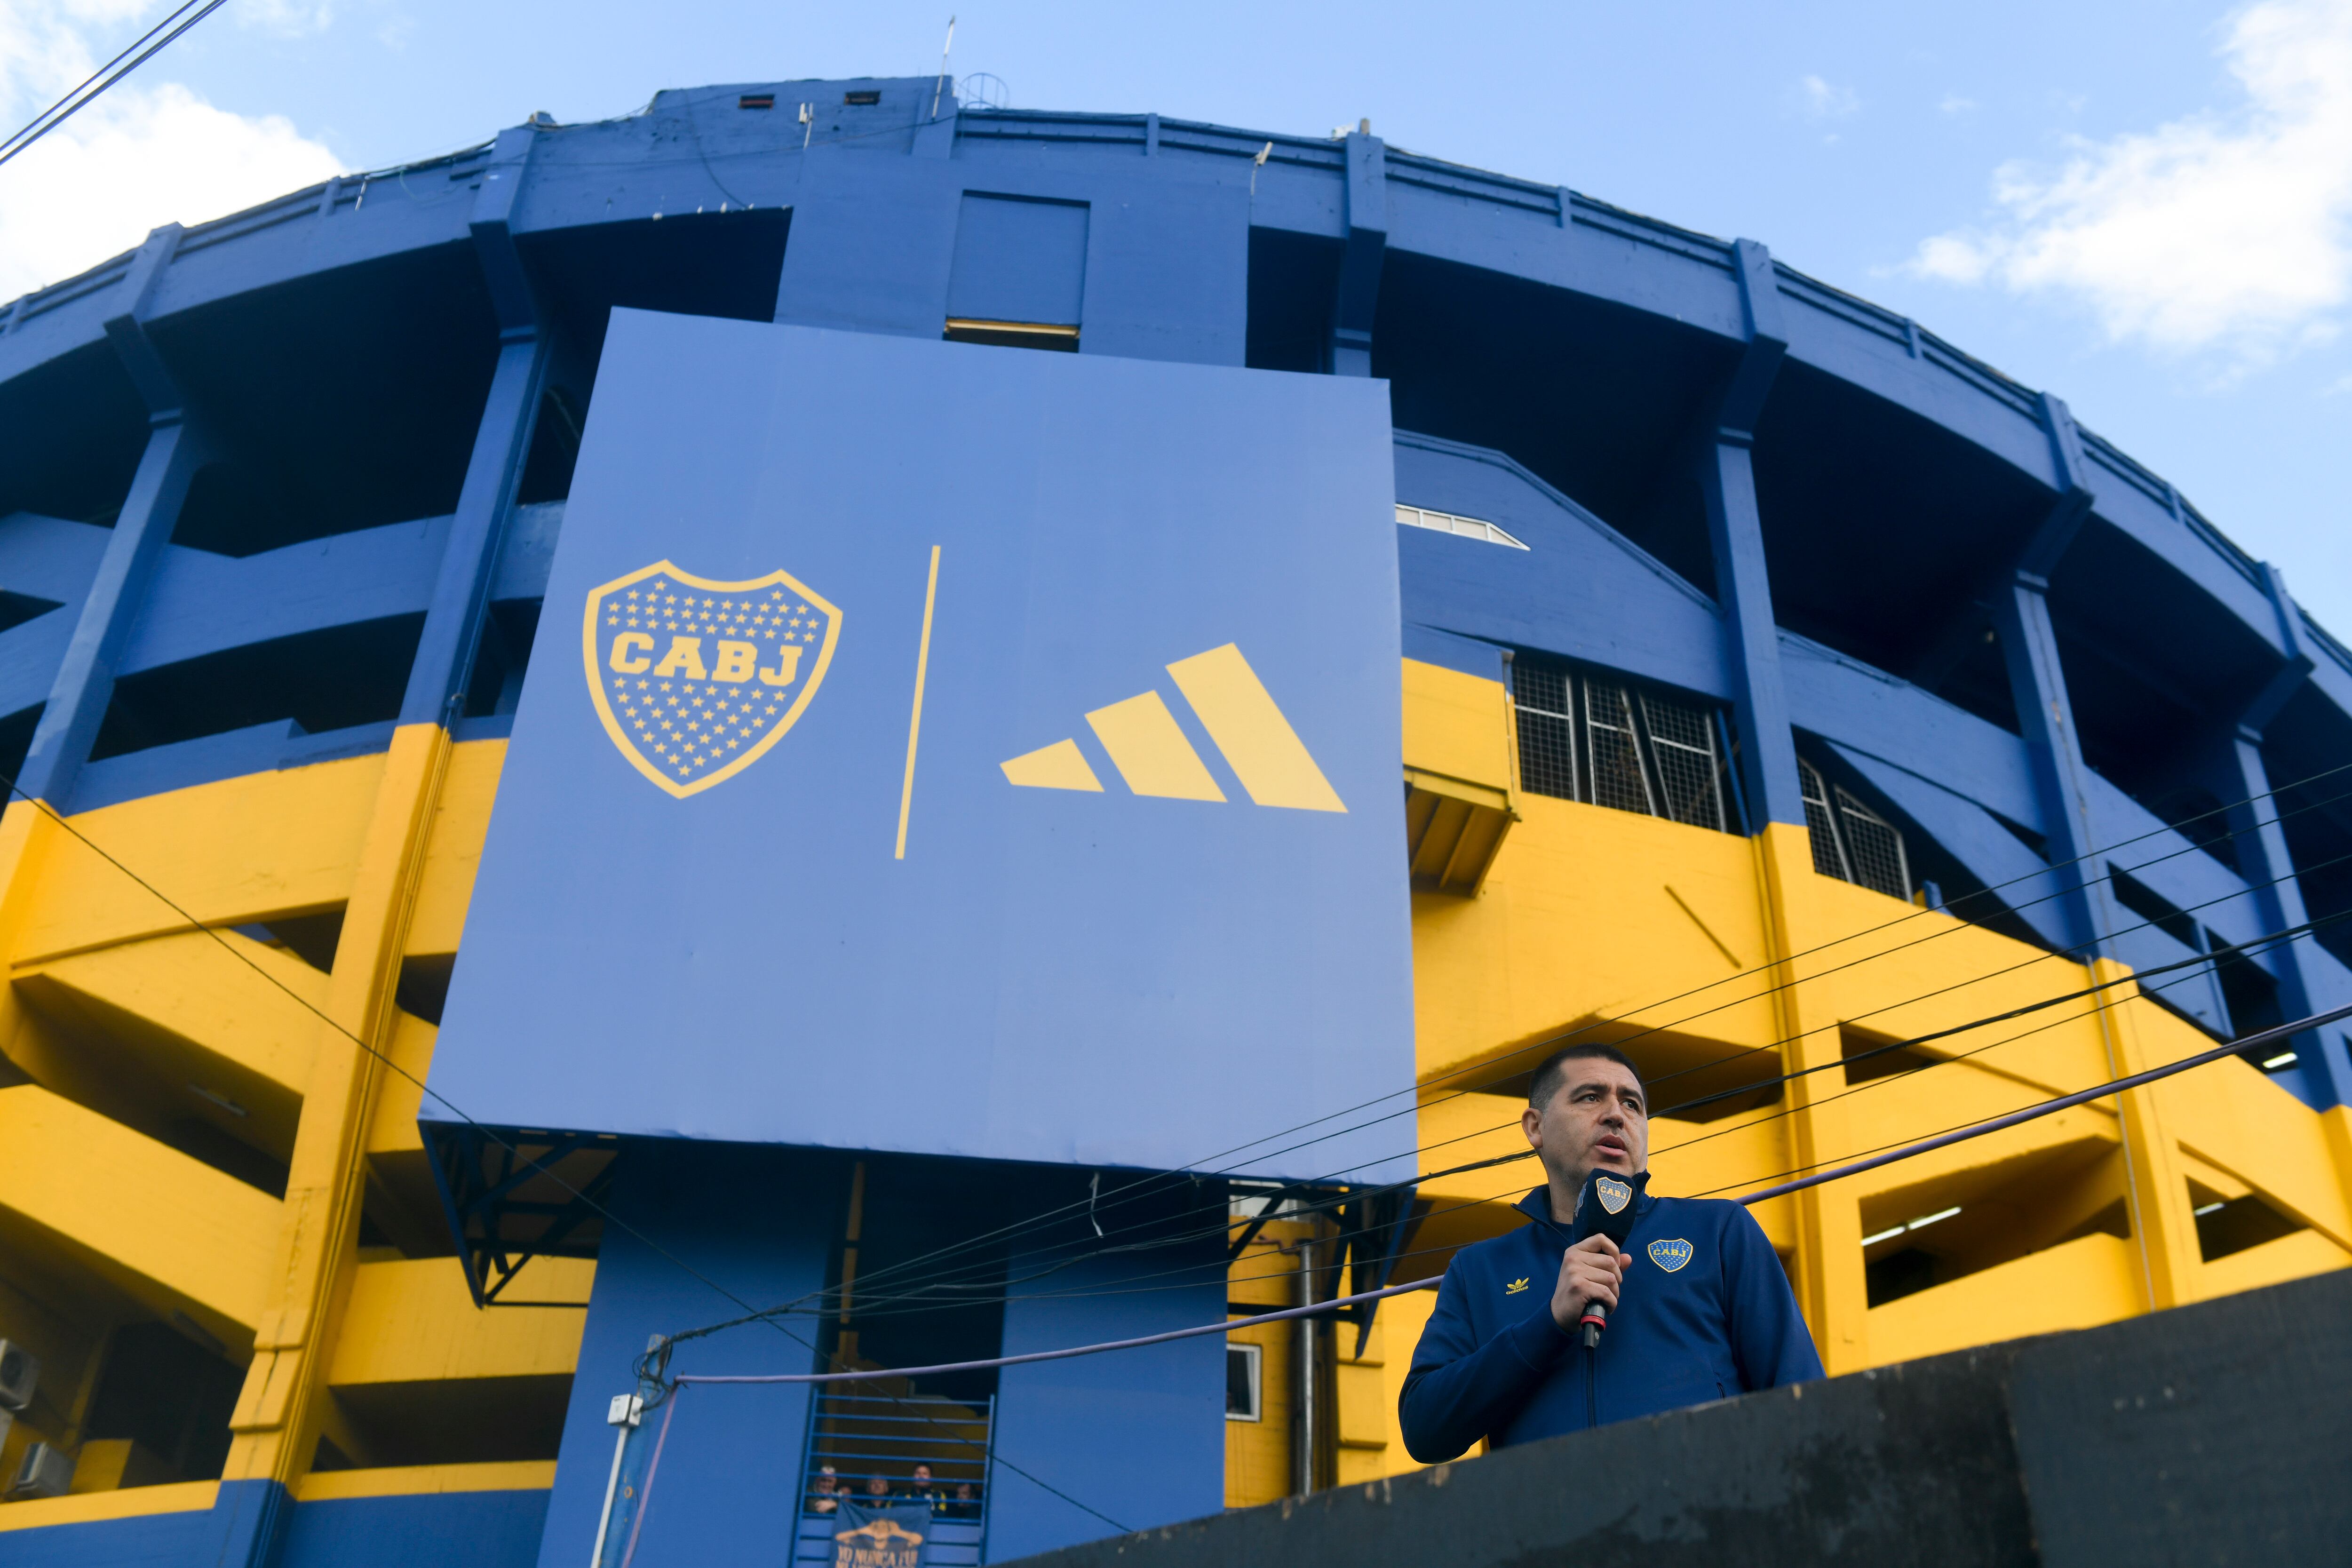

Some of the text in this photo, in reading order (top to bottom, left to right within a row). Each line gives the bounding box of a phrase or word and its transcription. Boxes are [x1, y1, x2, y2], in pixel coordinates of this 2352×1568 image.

[609, 631, 803, 687] CABJ
[1600, 1186, 1627, 1199] CABJ
[1653, 1249, 1686, 1257] CABJ
[1506, 1285, 1528, 1295] adidas
